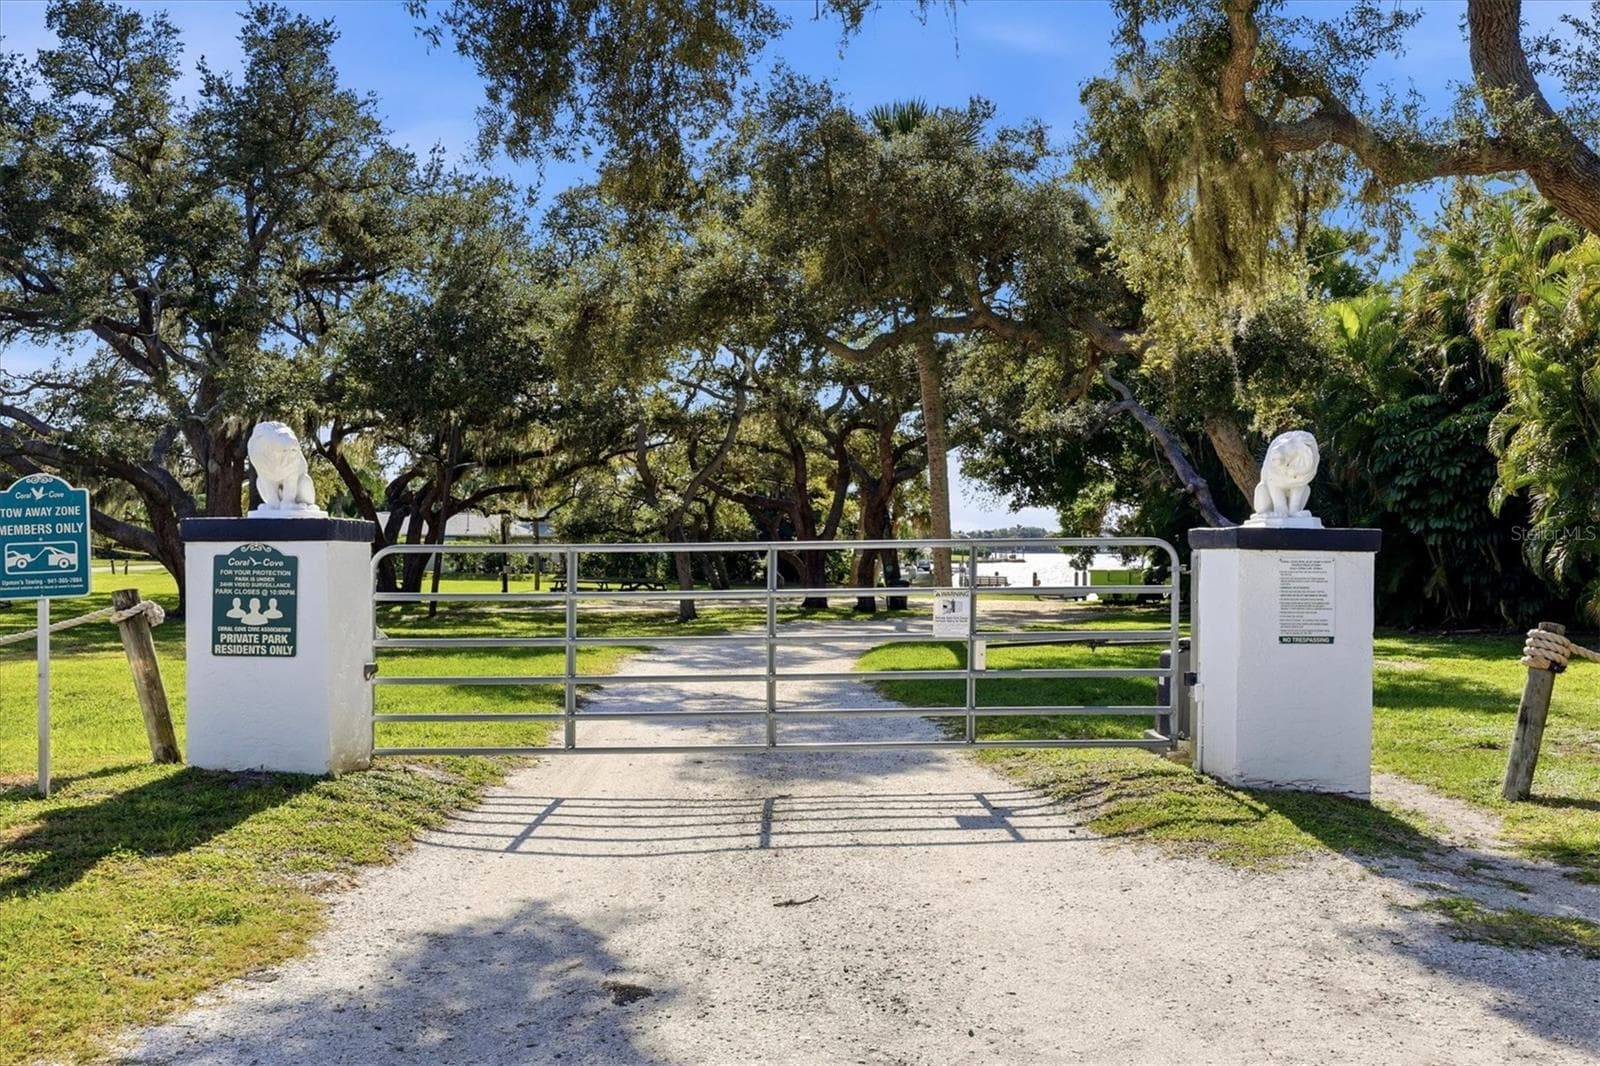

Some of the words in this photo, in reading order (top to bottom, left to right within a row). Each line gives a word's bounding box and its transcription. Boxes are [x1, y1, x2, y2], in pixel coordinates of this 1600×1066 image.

[15, 491, 32, 499] Coral
[0, 508, 22, 518] TOW
[25, 507, 52, 517] AWAY
[55, 506, 80, 516] ZONE
[0, 524, 52, 536] MEMBERS
[56, 522, 84, 534] ONLY
[228, 558, 250, 566] Coral
[262, 558, 284, 567] Cove
[220, 634, 260, 644] PRIVATE
[262, 634, 288, 644] PARK
[214, 644, 267, 654] RESIDENTS
[269, 645, 294, 655] ONLY
